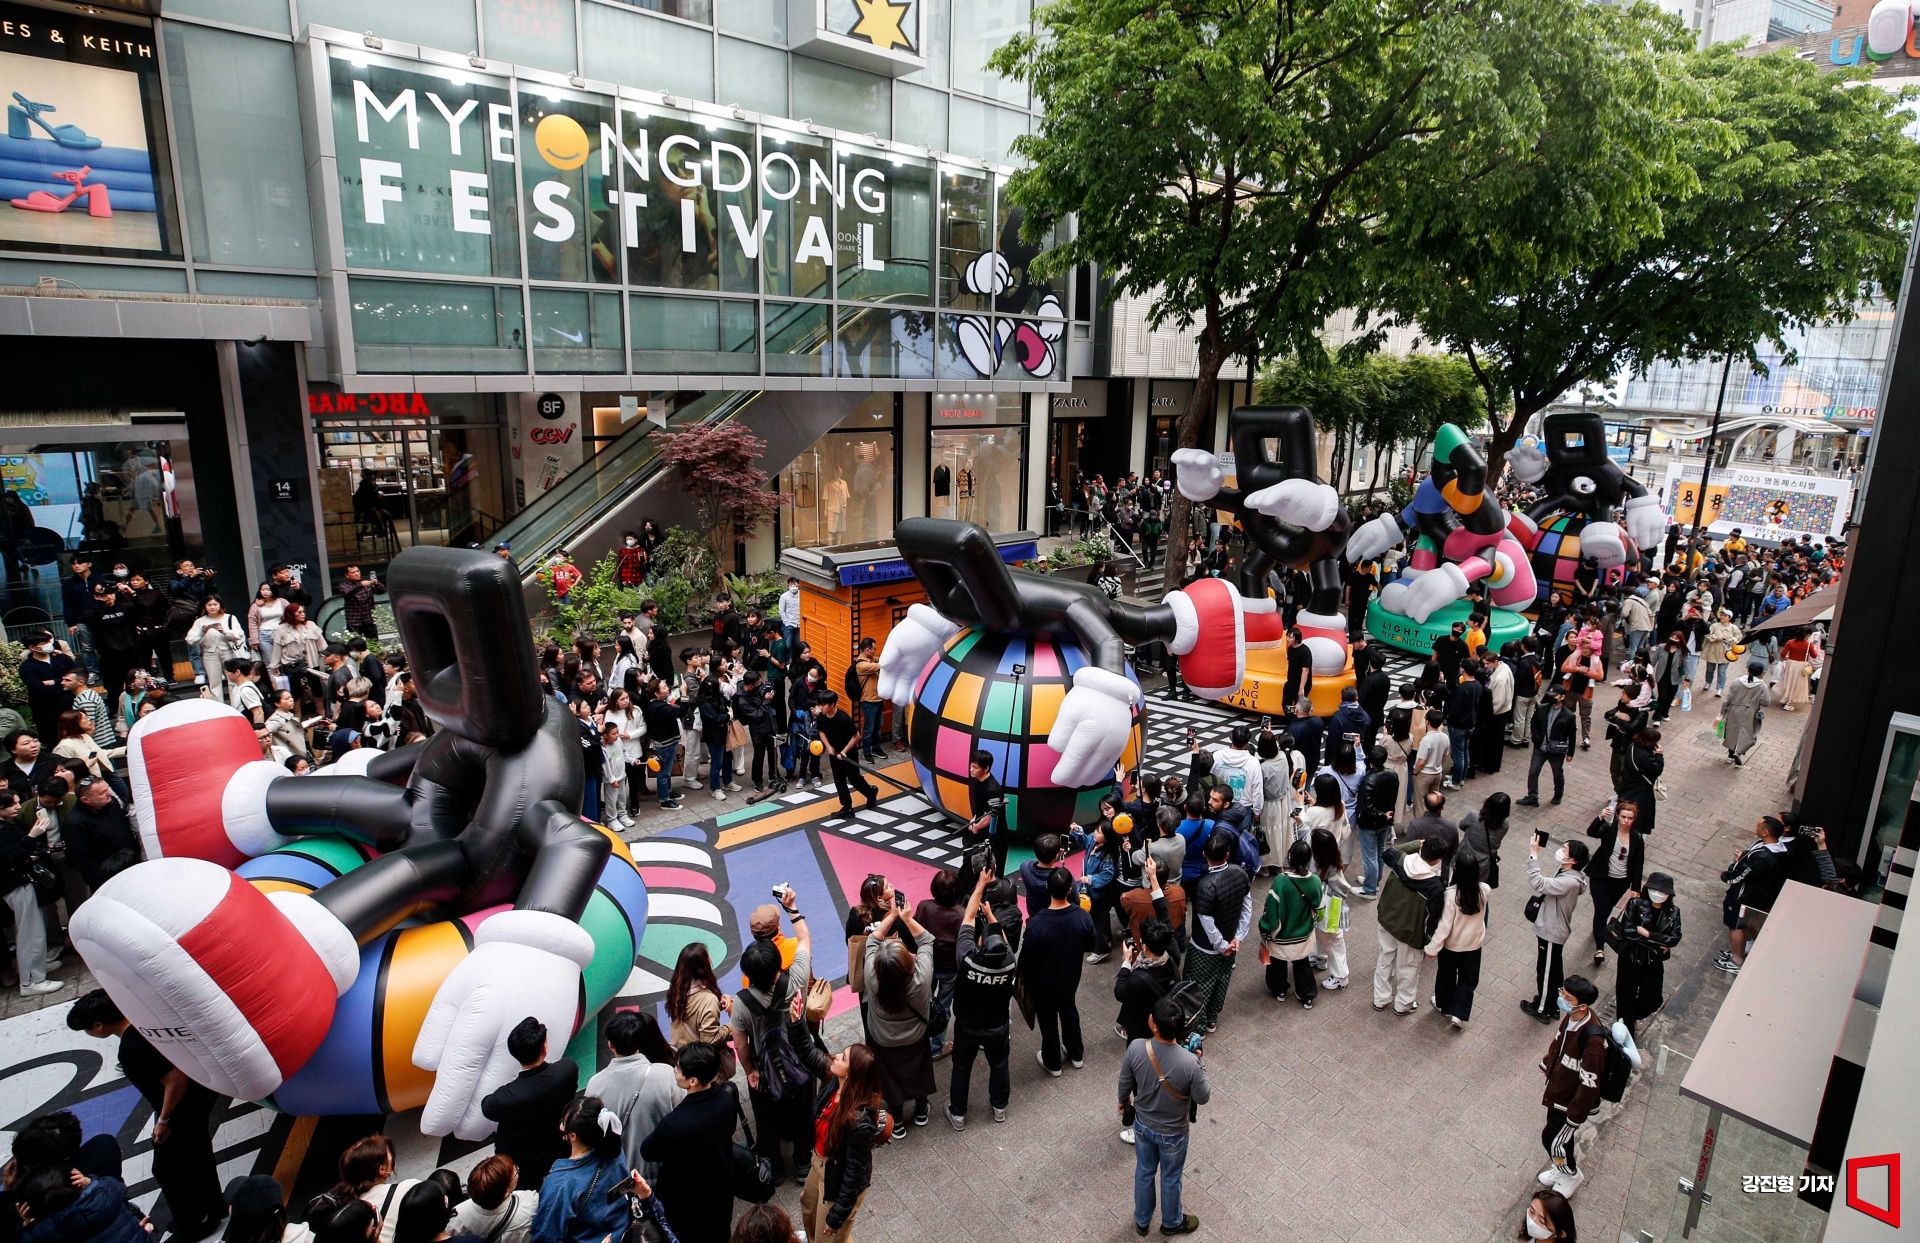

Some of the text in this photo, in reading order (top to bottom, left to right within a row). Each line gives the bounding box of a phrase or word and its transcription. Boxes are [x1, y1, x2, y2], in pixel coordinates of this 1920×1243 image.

[2, 20, 151, 58] ES & KEITH
[360, 158, 885, 271] FESTIVAL
[542, 401, 560, 413] 8F
[1053, 398, 1088, 408] ZARA
[1775, 407, 1817, 416] LOTTE
[530, 424, 574, 444] CGV
[275, 482, 291, 491] 14
[1737, 474, 1760, 483] 2023
[1764, 477, 1816, 490] 명동페스티벌
[1382, 621, 1420, 637] LIGHT
[967, 970, 1008, 984] STAFF
